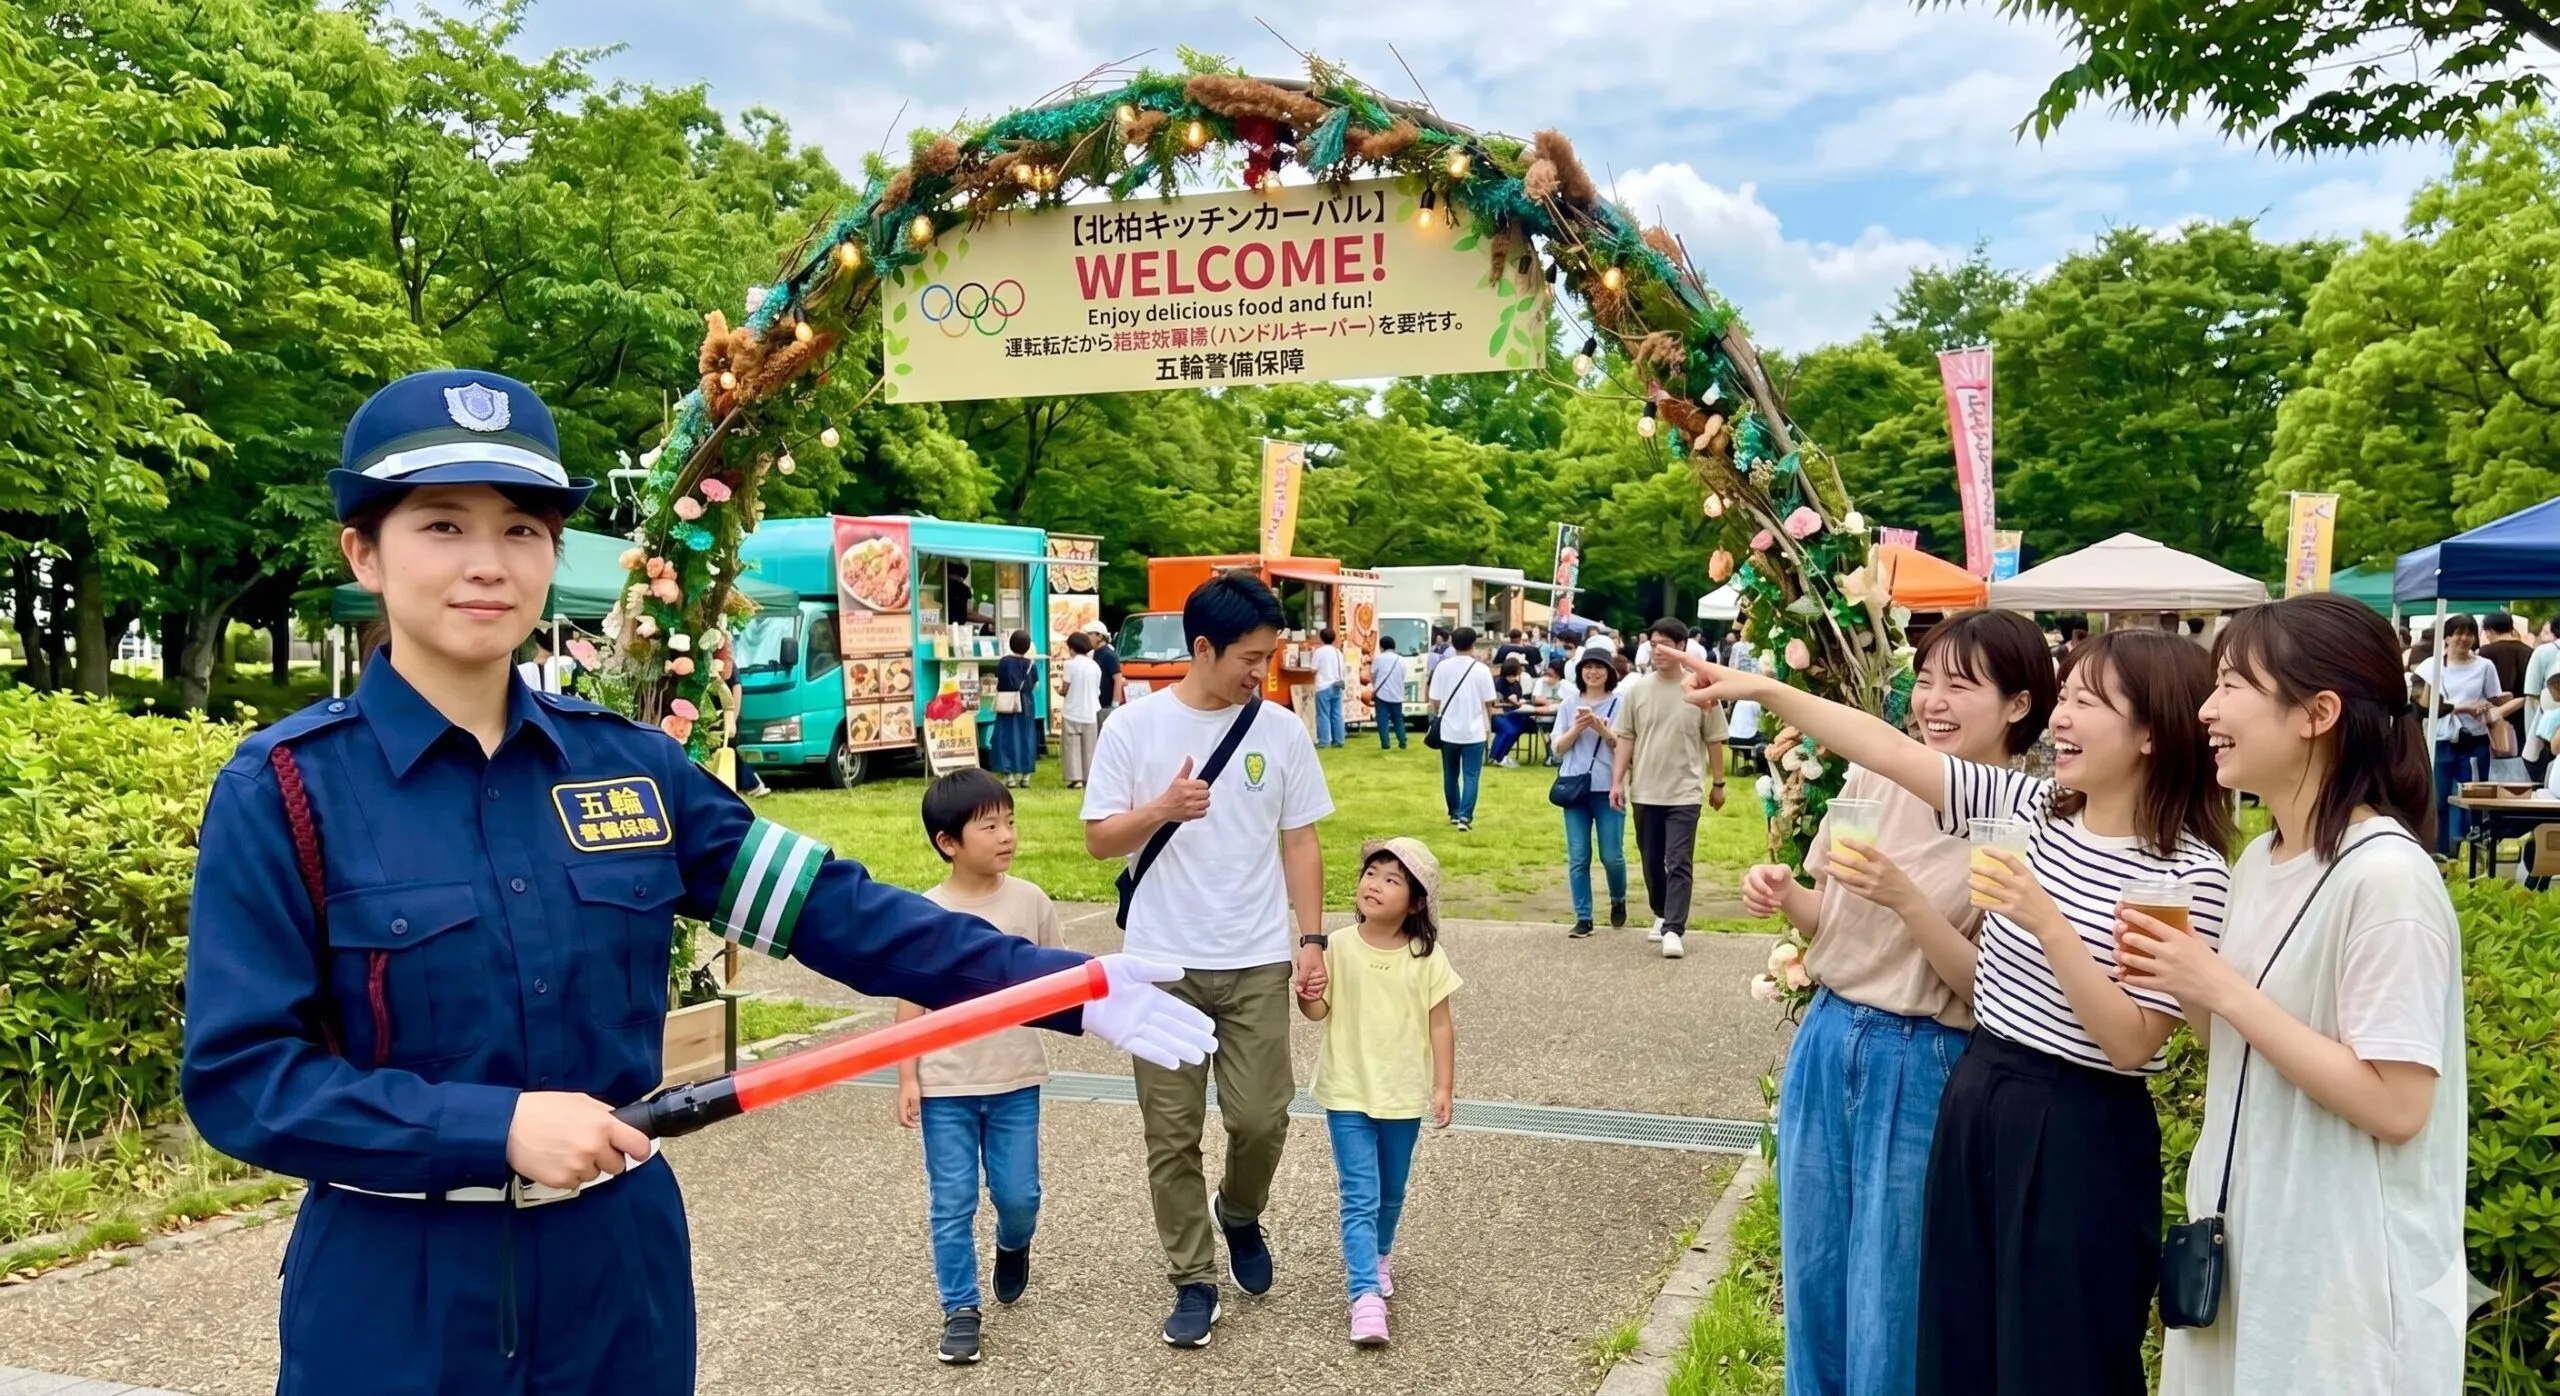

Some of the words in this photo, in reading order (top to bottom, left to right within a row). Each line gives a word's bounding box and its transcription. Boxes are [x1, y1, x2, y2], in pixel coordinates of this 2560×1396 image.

[1073, 191, 1385, 246] 【北柏キッチンカーバル】
[1075, 233, 1386, 300] WELCOME!
[1088, 307, 1140, 328] Enjoy
[1146, 301, 1232, 322] delicious
[1238, 296, 1283, 316] food
[1289, 294, 1326, 313] and
[1332, 291, 1373, 310] fun!
[1156, 348, 1305, 381] 五輪警備保障
[575, 787, 645, 819] 五輪
